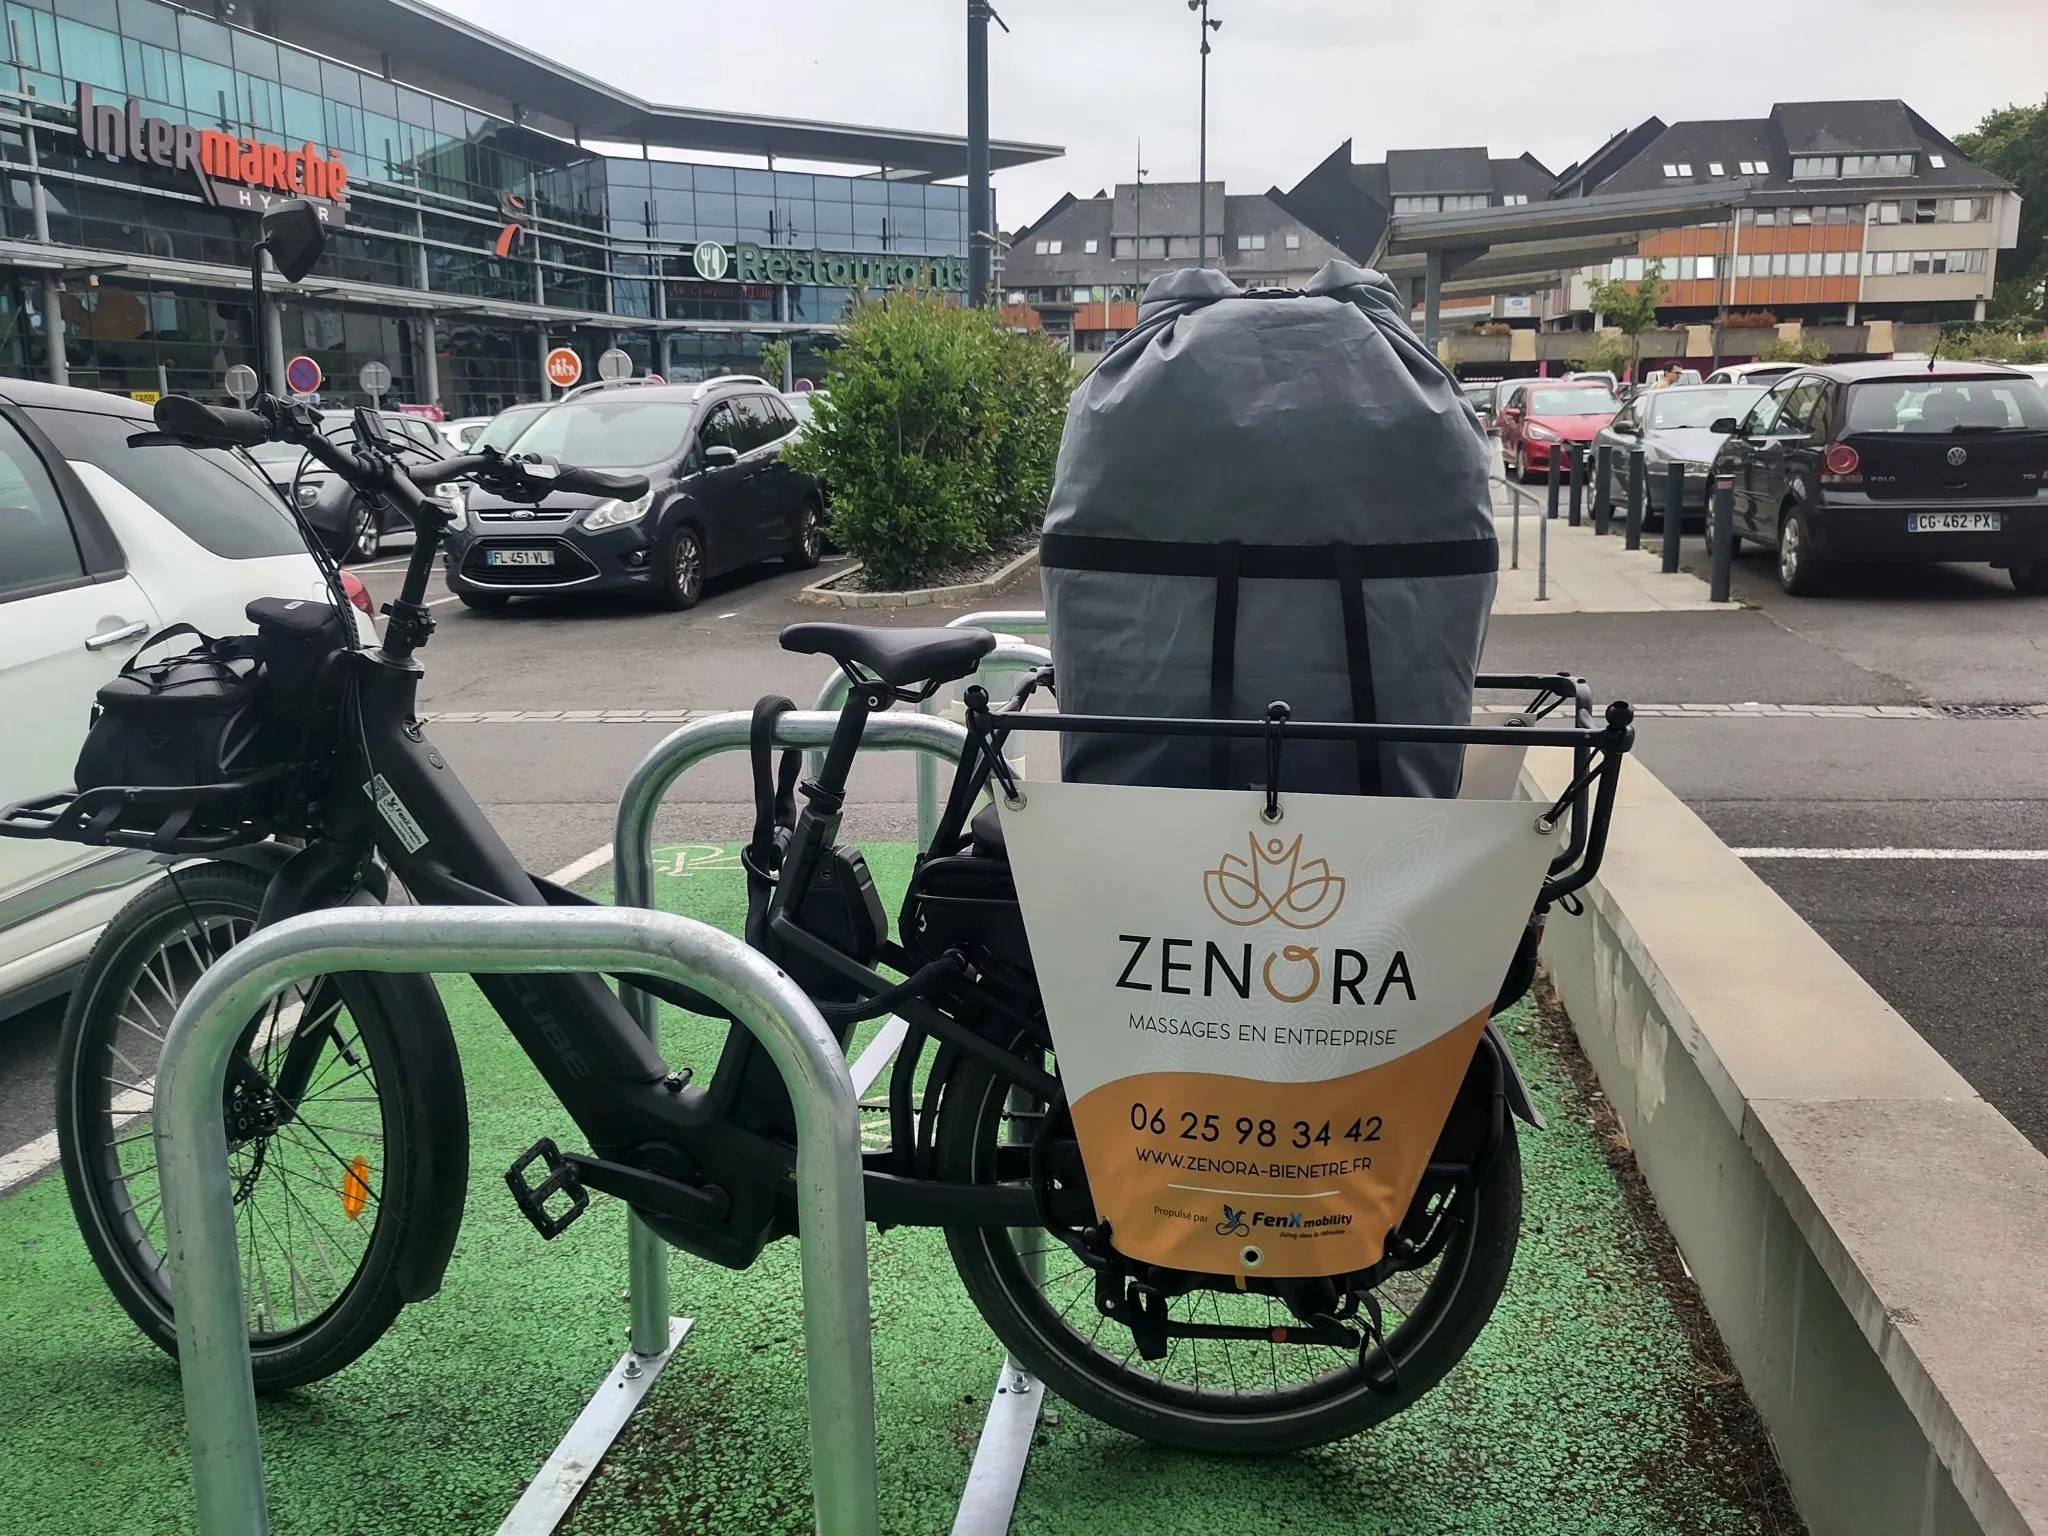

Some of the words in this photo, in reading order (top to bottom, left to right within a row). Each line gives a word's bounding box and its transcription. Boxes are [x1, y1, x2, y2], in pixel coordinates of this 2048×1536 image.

[238, 191, 329, 222] HYR
[1919, 514, 1991, 529] CG-462-PX
[494, 552, 547, 564] FL-451-VL
[1115, 934, 1417, 1006] ZENORA
[1129, 1013, 1231, 1040] MASSAGES
[1238, 1025, 1266, 1043] EN
[1274, 1027, 1397, 1047] ENTREPRISE
[1131, 1102, 1166, 1135] 06
[1179, 1111, 1220, 1142] 25
[1235, 1117, 1277, 1147] 98
[1292, 1120, 1331, 1149] 34
[1344, 1116, 1383, 1142] 42
[1135, 1147, 1372, 1179] WWW.ZENORA-BIENETRE.FR
[1154, 1206, 1191, 1221] Propulsé
[1193, 1214, 1208, 1223] par
[1252, 1211, 1302, 1228] FenX
[1303, 1214, 1353, 1228] mobility
